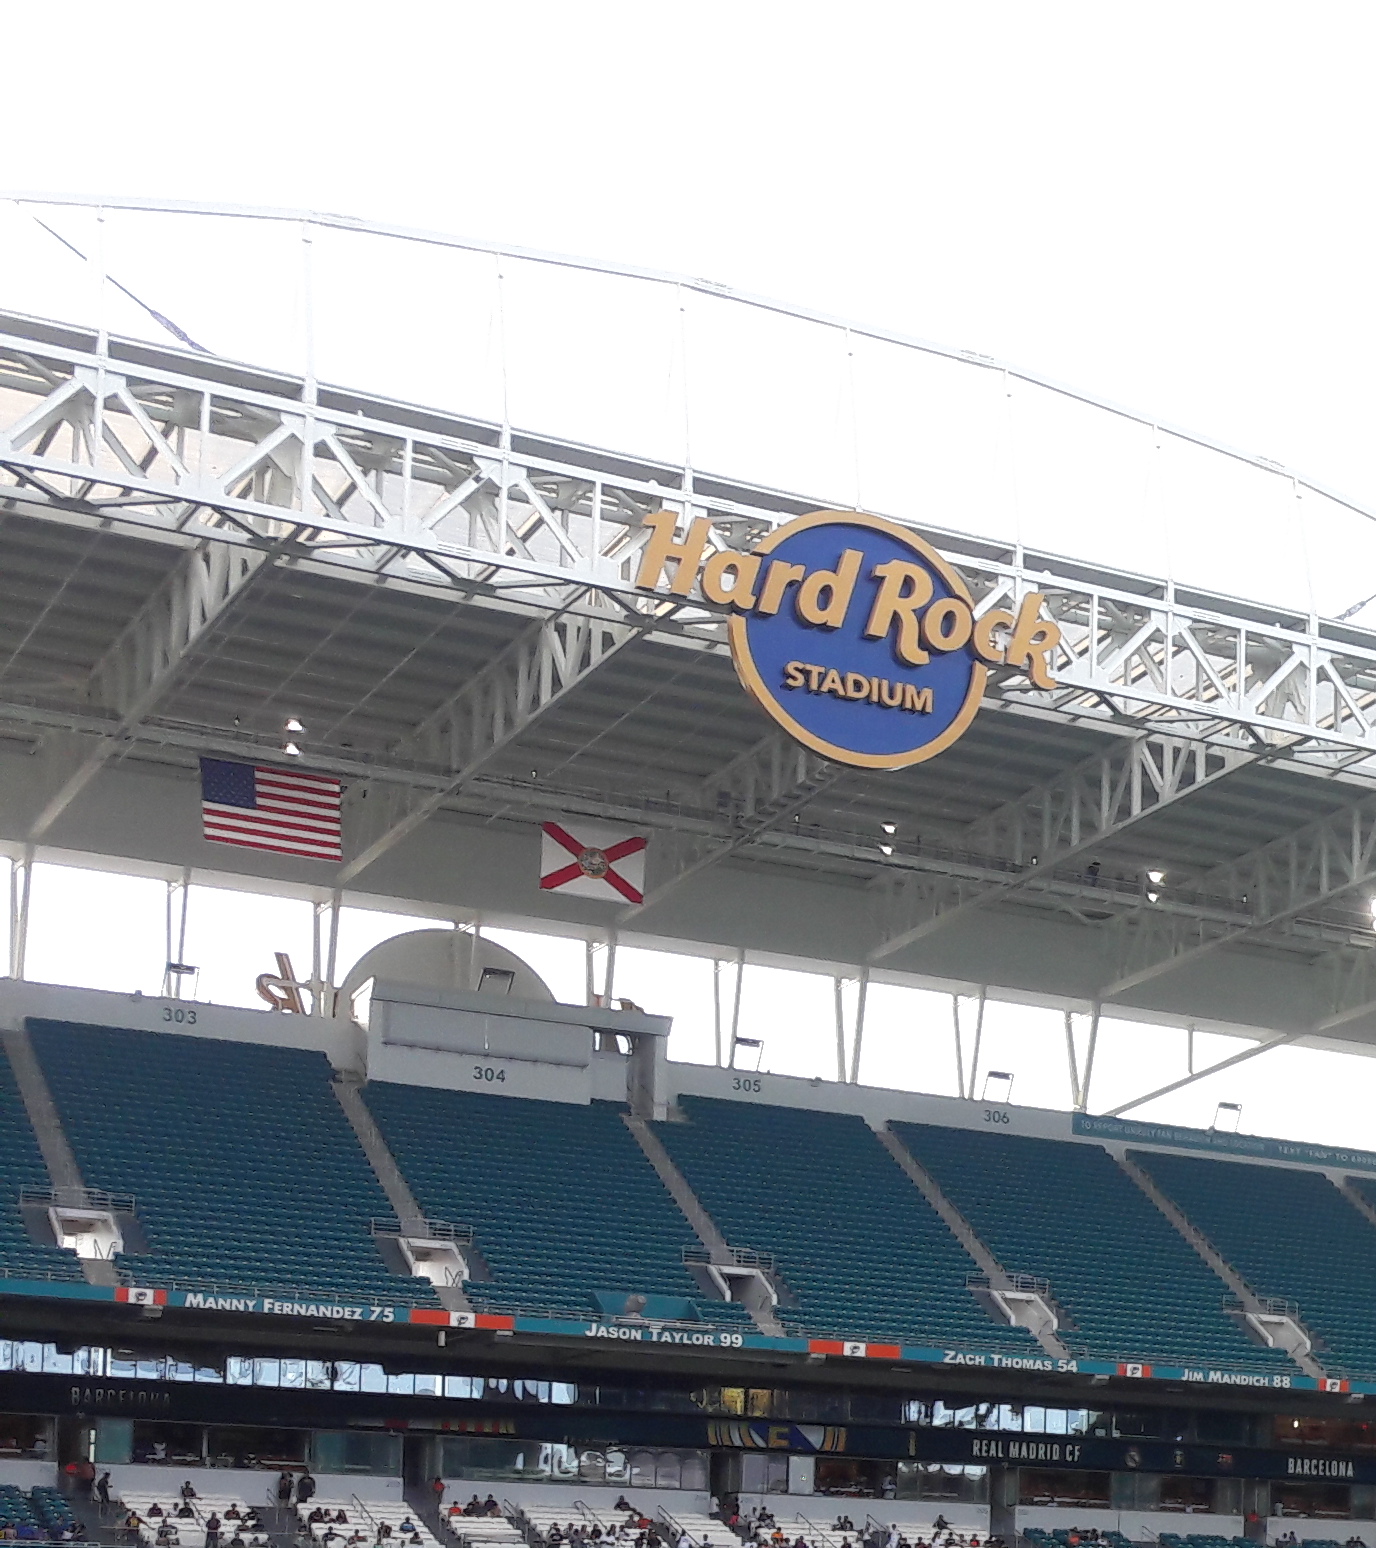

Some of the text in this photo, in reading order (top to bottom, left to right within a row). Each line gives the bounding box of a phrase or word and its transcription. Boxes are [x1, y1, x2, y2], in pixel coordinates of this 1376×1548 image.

[634, 509, 1060, 690] Hard Rock
[783, 660, 935, 714] STADIUM
[163, 1008, 197, 1025] 303
[473, 1066, 506, 1083] 304
[732, 1078, 761, 1093] 305
[984, 1110, 1010, 1124] 306
[185, 1293, 394, 1322] MANNY FERNANDEZ 75
[585, 1322, 743, 1348] JASON TAYLOR 99
[943, 1350, 1078, 1373] ZACH THOMAS 54
[1181, 1369, 1291, 1388] JIM MANDICH 88
[972, 1439, 1081, 1463] REAL MADRID CF
[1287, 1457, 1354, 1478] BARCELONA
